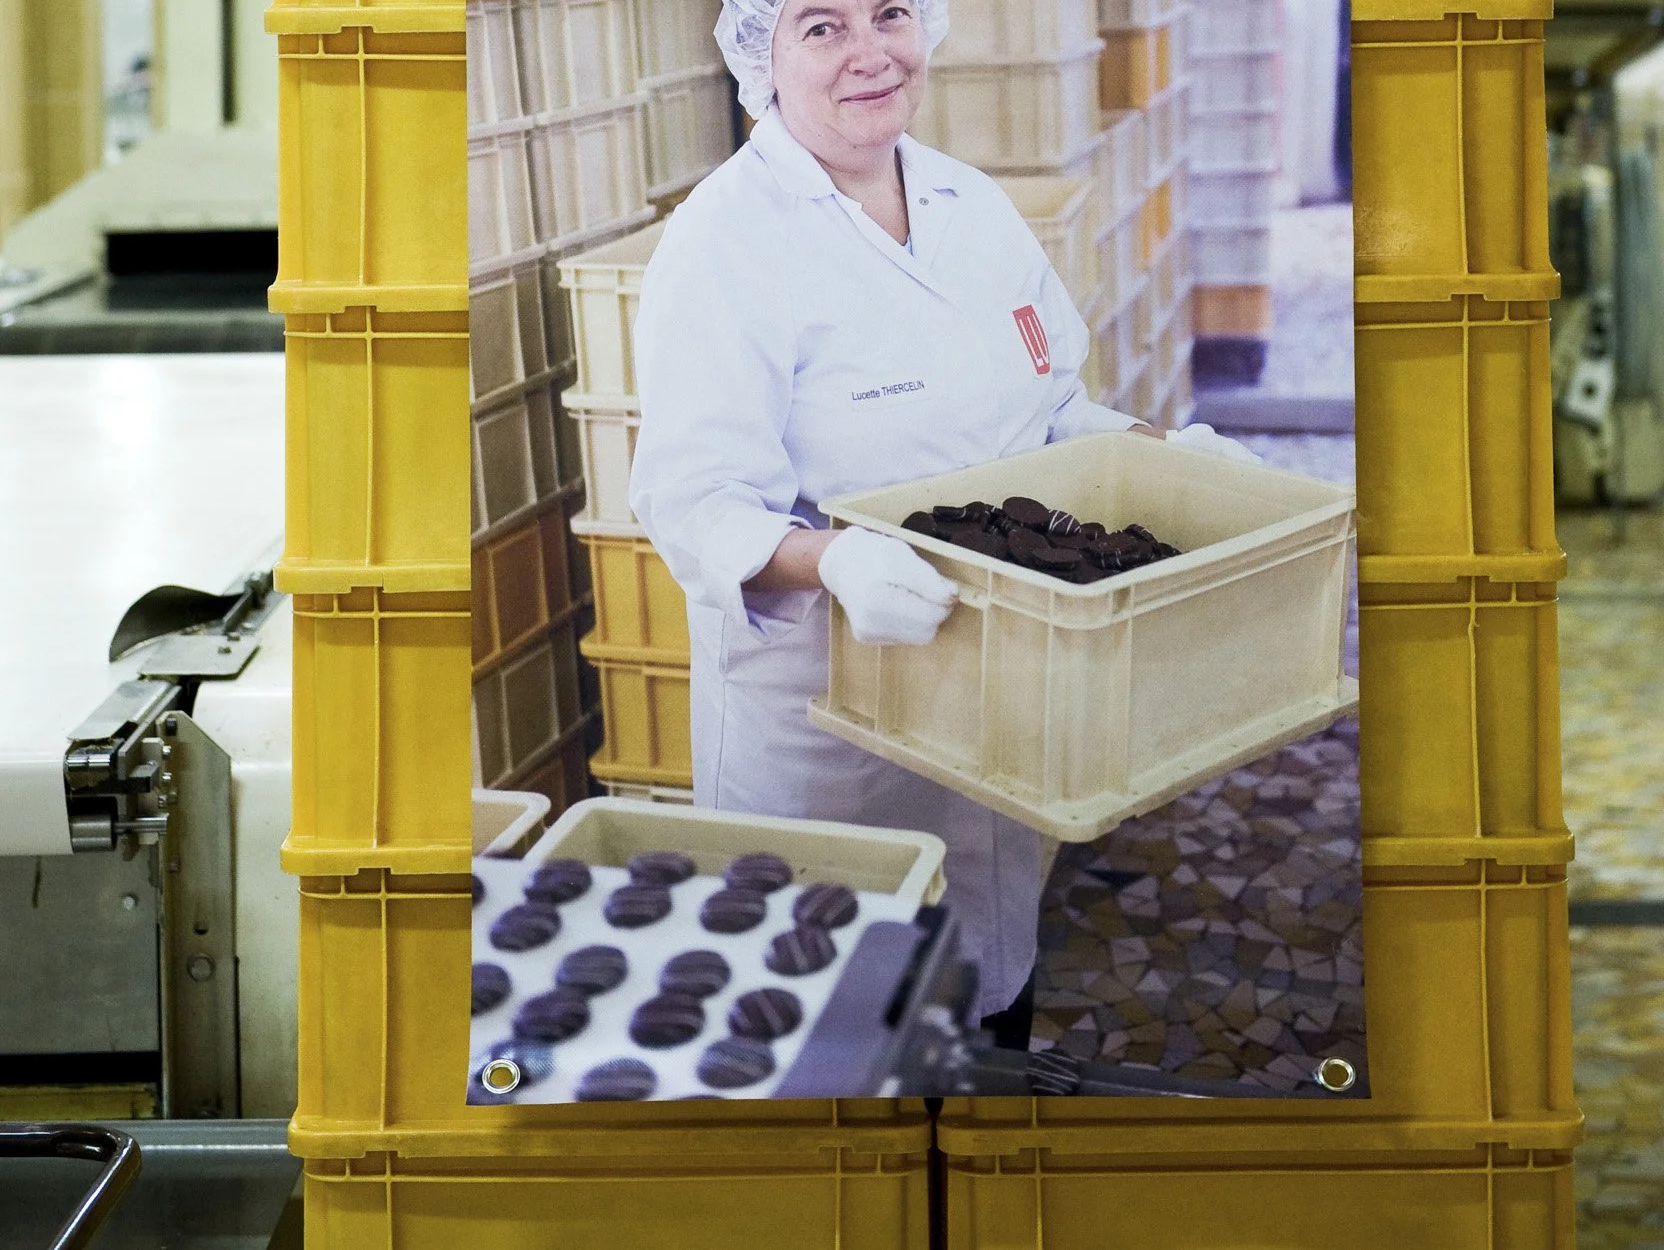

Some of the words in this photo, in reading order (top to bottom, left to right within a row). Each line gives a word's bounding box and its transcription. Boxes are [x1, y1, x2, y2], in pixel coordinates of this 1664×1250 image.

[1018, 313, 1049, 367] LU
[852, 389, 881, 401] Lucette
[881, 380, 925, 397] THIERCELIN
